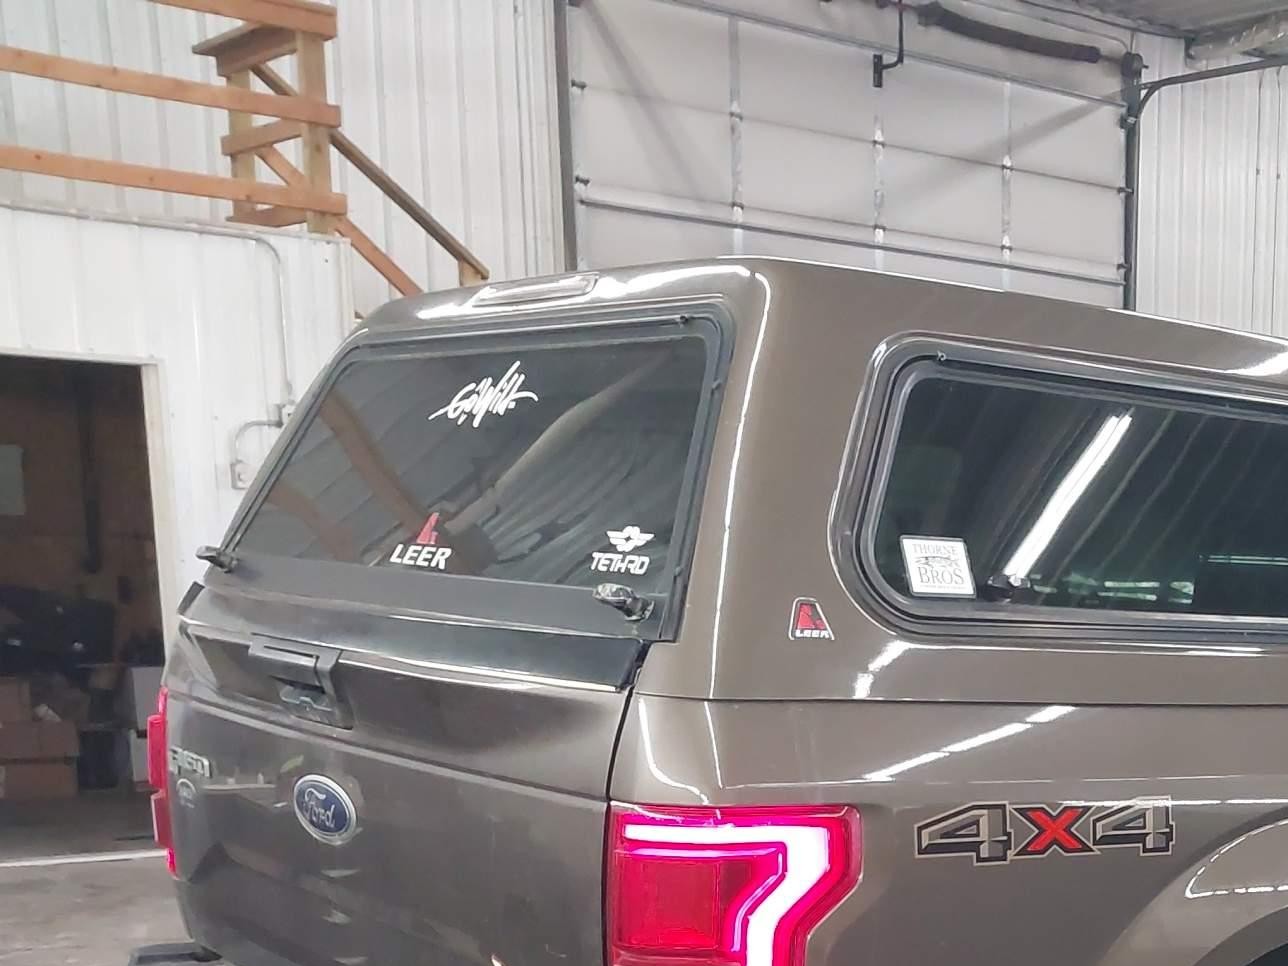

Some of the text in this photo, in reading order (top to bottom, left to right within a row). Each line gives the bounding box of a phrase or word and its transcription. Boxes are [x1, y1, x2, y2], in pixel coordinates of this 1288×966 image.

[390, 543, 452, 570] LEER
[912, 543, 960, 556] THORNE
[917, 566, 965, 585] BROS
[795, 629, 830, 638] LEER
[303, 787, 337, 828] Ford
